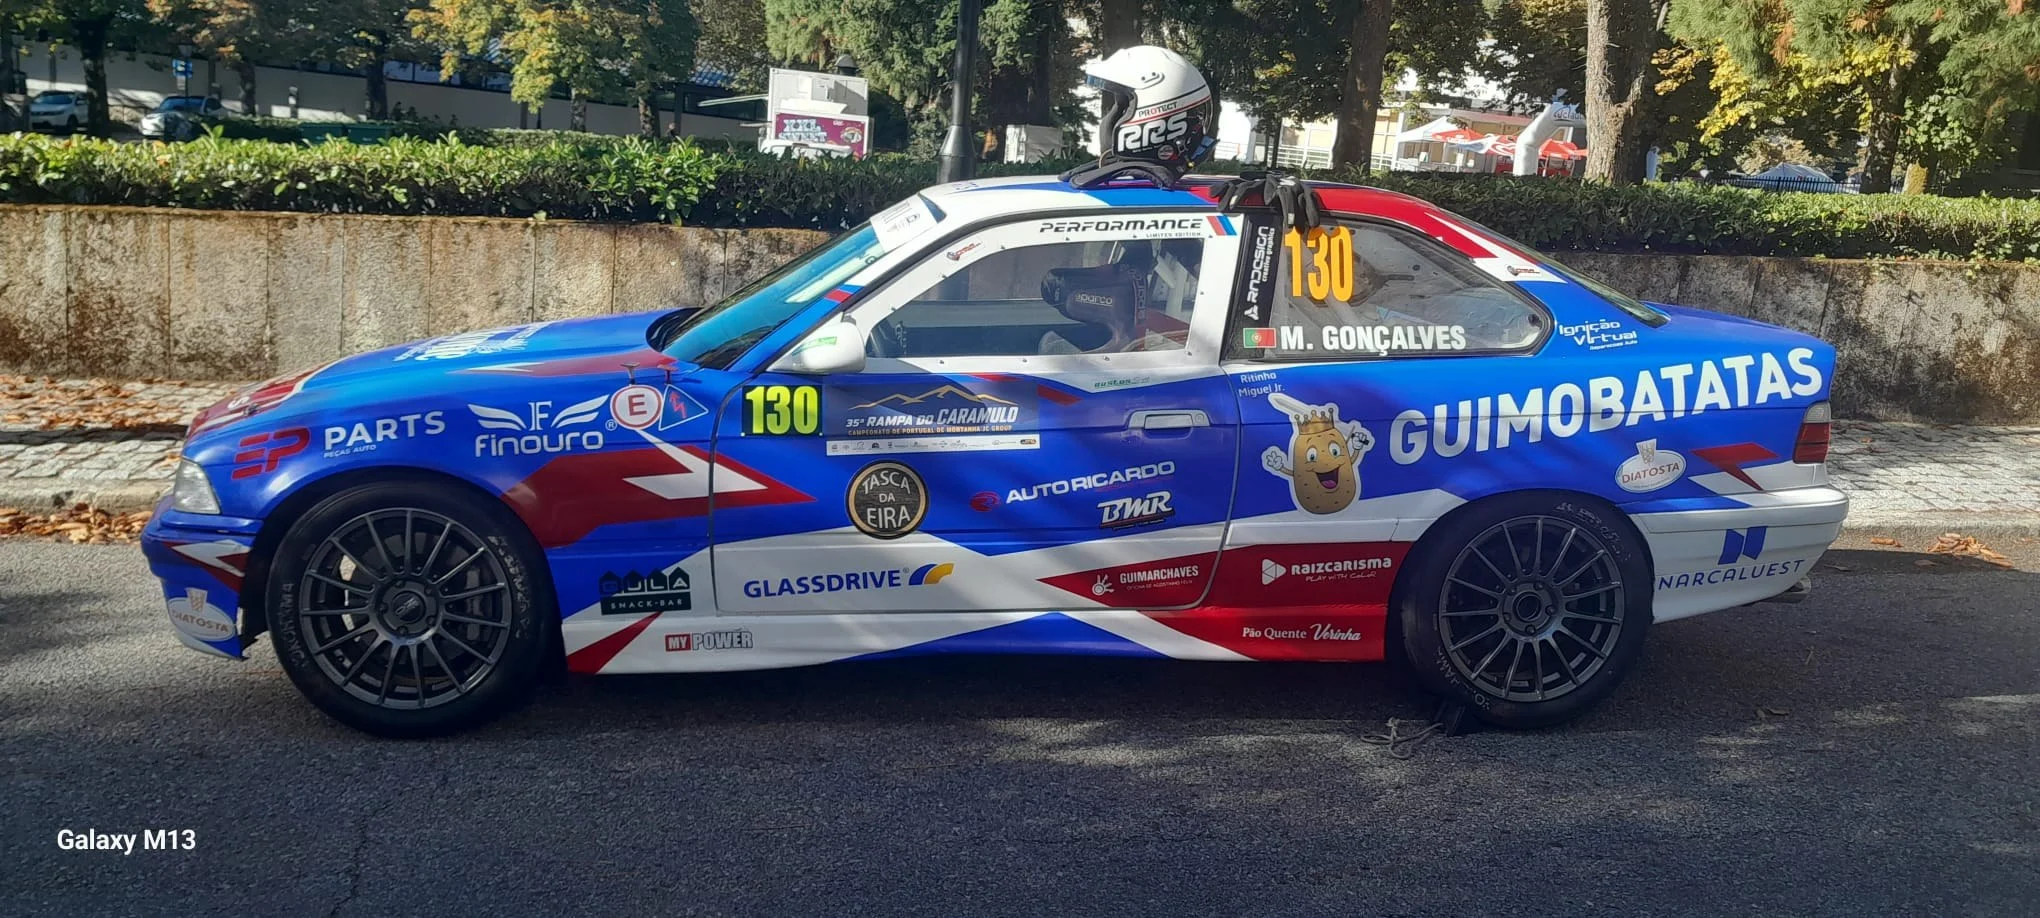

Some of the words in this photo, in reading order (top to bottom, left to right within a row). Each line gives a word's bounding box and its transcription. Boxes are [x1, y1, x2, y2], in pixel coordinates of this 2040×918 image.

[1138, 101, 1177, 117] PROTECT
[1117, 111, 1188, 152] RRS
[1039, 218, 1203, 233] PERFORMANCE
[1284, 225, 1353, 302] 130
[1280, 325, 1313, 350] M.
[1322, 325, 1467, 356] GONÇALVES
[1238, 384, 1272, 397] Miguel
[1274, 383, 1286, 392] Jr.
[628, 394, 647, 416] E
[745, 386, 818, 434] 130
[866, 415, 913, 426] RAMPA
[915, 414, 935, 425] DO
[937, 406, 1019, 425] CARAMULO
[1388, 347, 1822, 465] GUIMOBATATAS
[324, 411, 446, 450] PARTS
[353, 444, 377, 453] AUTO
[475, 431, 603, 457] finouro
[862, 470, 911, 494] TASCA
[1006, 481, 1069, 504] AUTO
[1071, 460, 1175, 491] RICARDO
[1622, 462, 1680, 483] DIATOSTA
[879, 492, 896, 503] DA
[867, 506, 911, 529] EIRA
[743, 569, 901, 599] GLASSDRIVE
[1119, 565, 1199, 583] GUIMARCHAVES
[1658, 559, 1805, 591] NARCALUEST
[610, 598, 683, 610] SNACK-BAR
[668, 636, 688, 649] MY
[692, 631, 753, 650] POWER
[1242, 627, 1261, 638] Pão
[1264, 627, 1307, 639] Quente
[1310, 623, 1361, 641] Verinha
